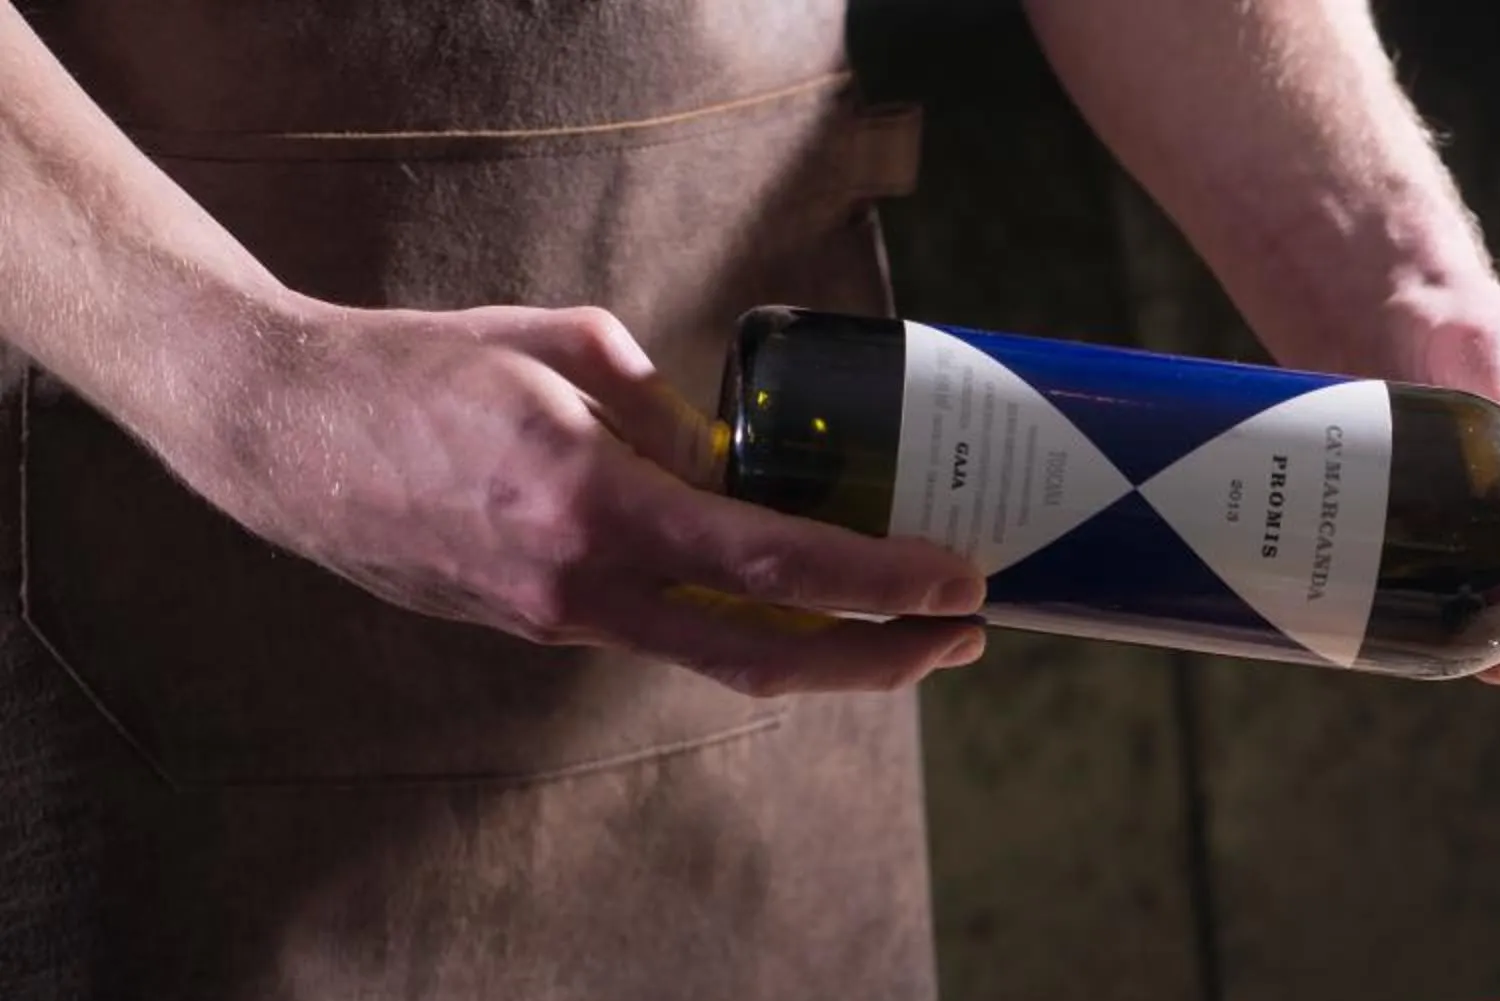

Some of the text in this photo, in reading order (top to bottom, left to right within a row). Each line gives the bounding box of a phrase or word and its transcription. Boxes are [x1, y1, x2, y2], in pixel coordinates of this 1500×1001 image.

[951, 442, 970, 492] GAJA
[1262, 454, 1289, 559] PROMIS
[1308, 425, 1343, 602] CA' MARCANDA
